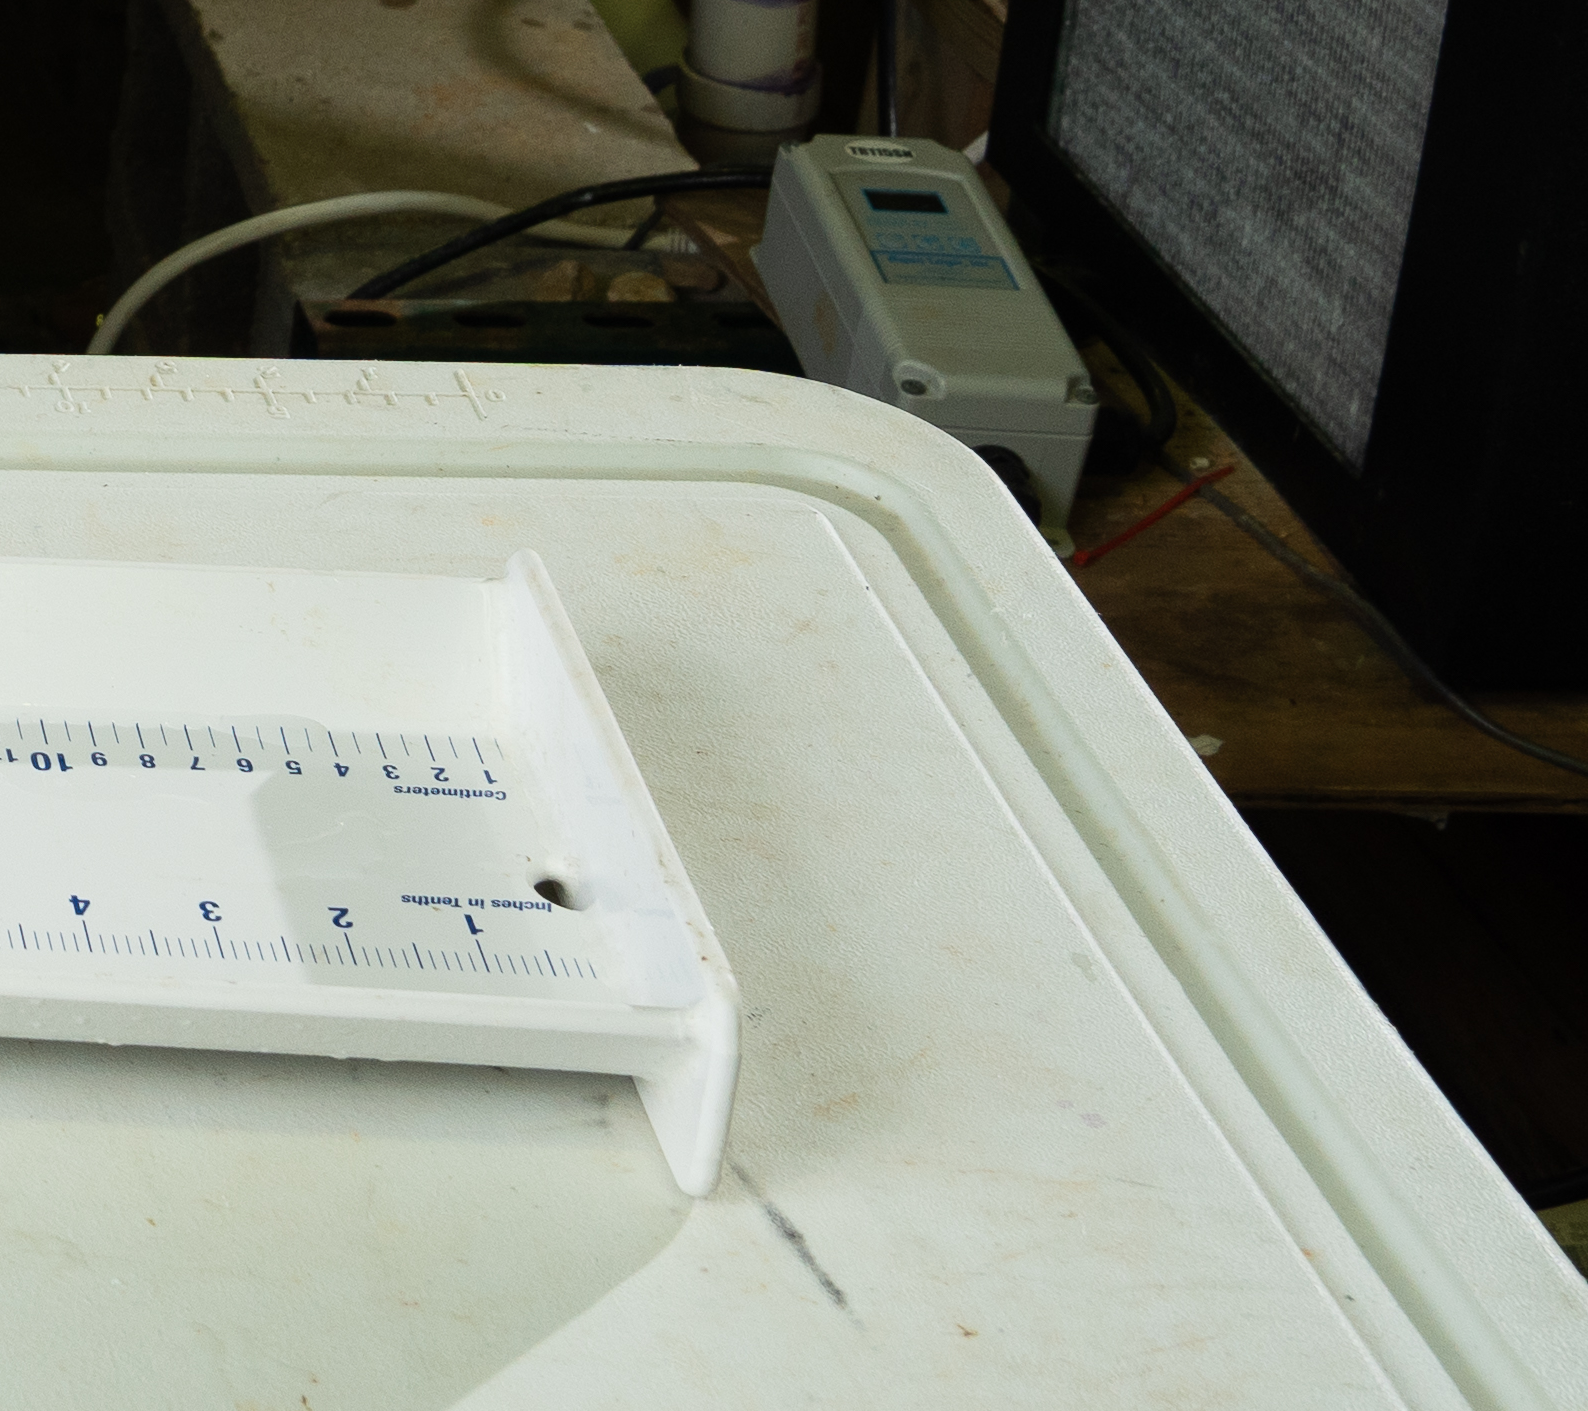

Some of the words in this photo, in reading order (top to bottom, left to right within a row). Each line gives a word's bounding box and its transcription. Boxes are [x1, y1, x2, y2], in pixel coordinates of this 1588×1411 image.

[30, 752, 73, 772] 10
[91, 752, 107, 766] 9
[139, 754, 156, 768] 8
[190, 756, 205, 770] 7
[236, 758, 253, 772] 6
[285, 761, 302, 775] 5
[334, 763, 349, 777] 4
[383, 765, 400, 779] 3
[431, 767, 449, 782] 2
[484, 770, 497, 784] 1
[394, 786, 506, 800] Centimeters
[69, 895, 90, 915] 4
[401, 895, 462, 908] Tenths
[468, 898, 484, 909] in
[491, 899, 552, 912] Inches
[199, 901, 222, 922] 3
[328, 907, 353, 928] 2
[464, 914, 484, 935] 1
